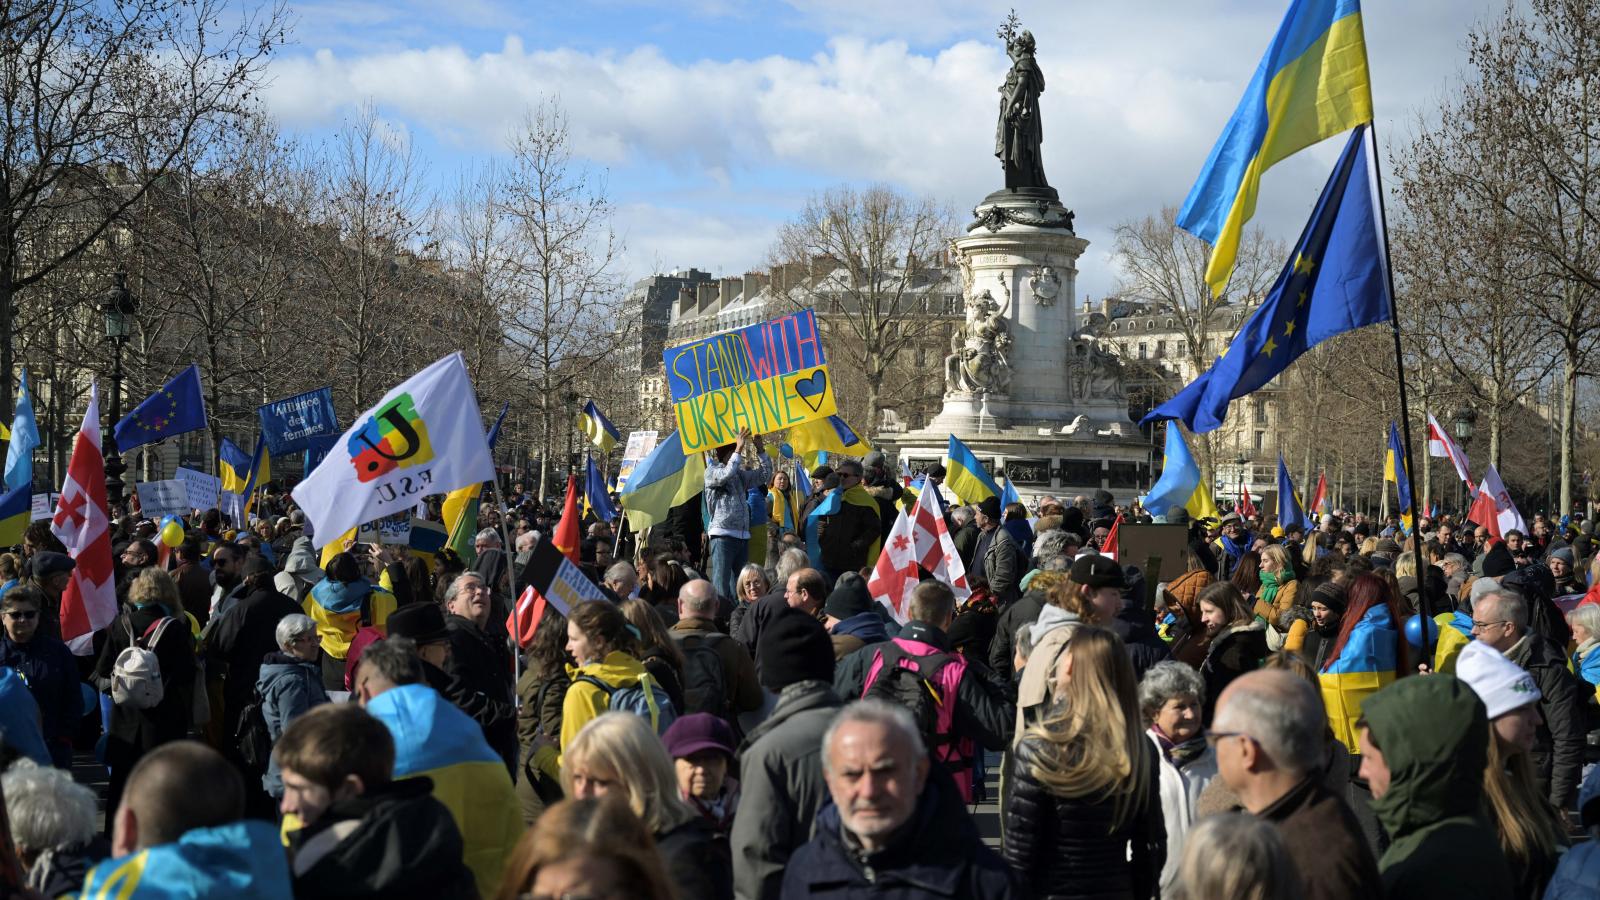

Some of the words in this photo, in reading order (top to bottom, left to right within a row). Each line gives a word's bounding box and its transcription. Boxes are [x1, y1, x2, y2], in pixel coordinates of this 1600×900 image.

[672, 333, 750, 401] STAND
[741, 311, 821, 381] WITH
[275, 397, 320, 417] Alliance
[678, 371, 806, 450] UKRAINE
[288, 415, 306, 427] des
[283, 423, 324, 441] femmes
